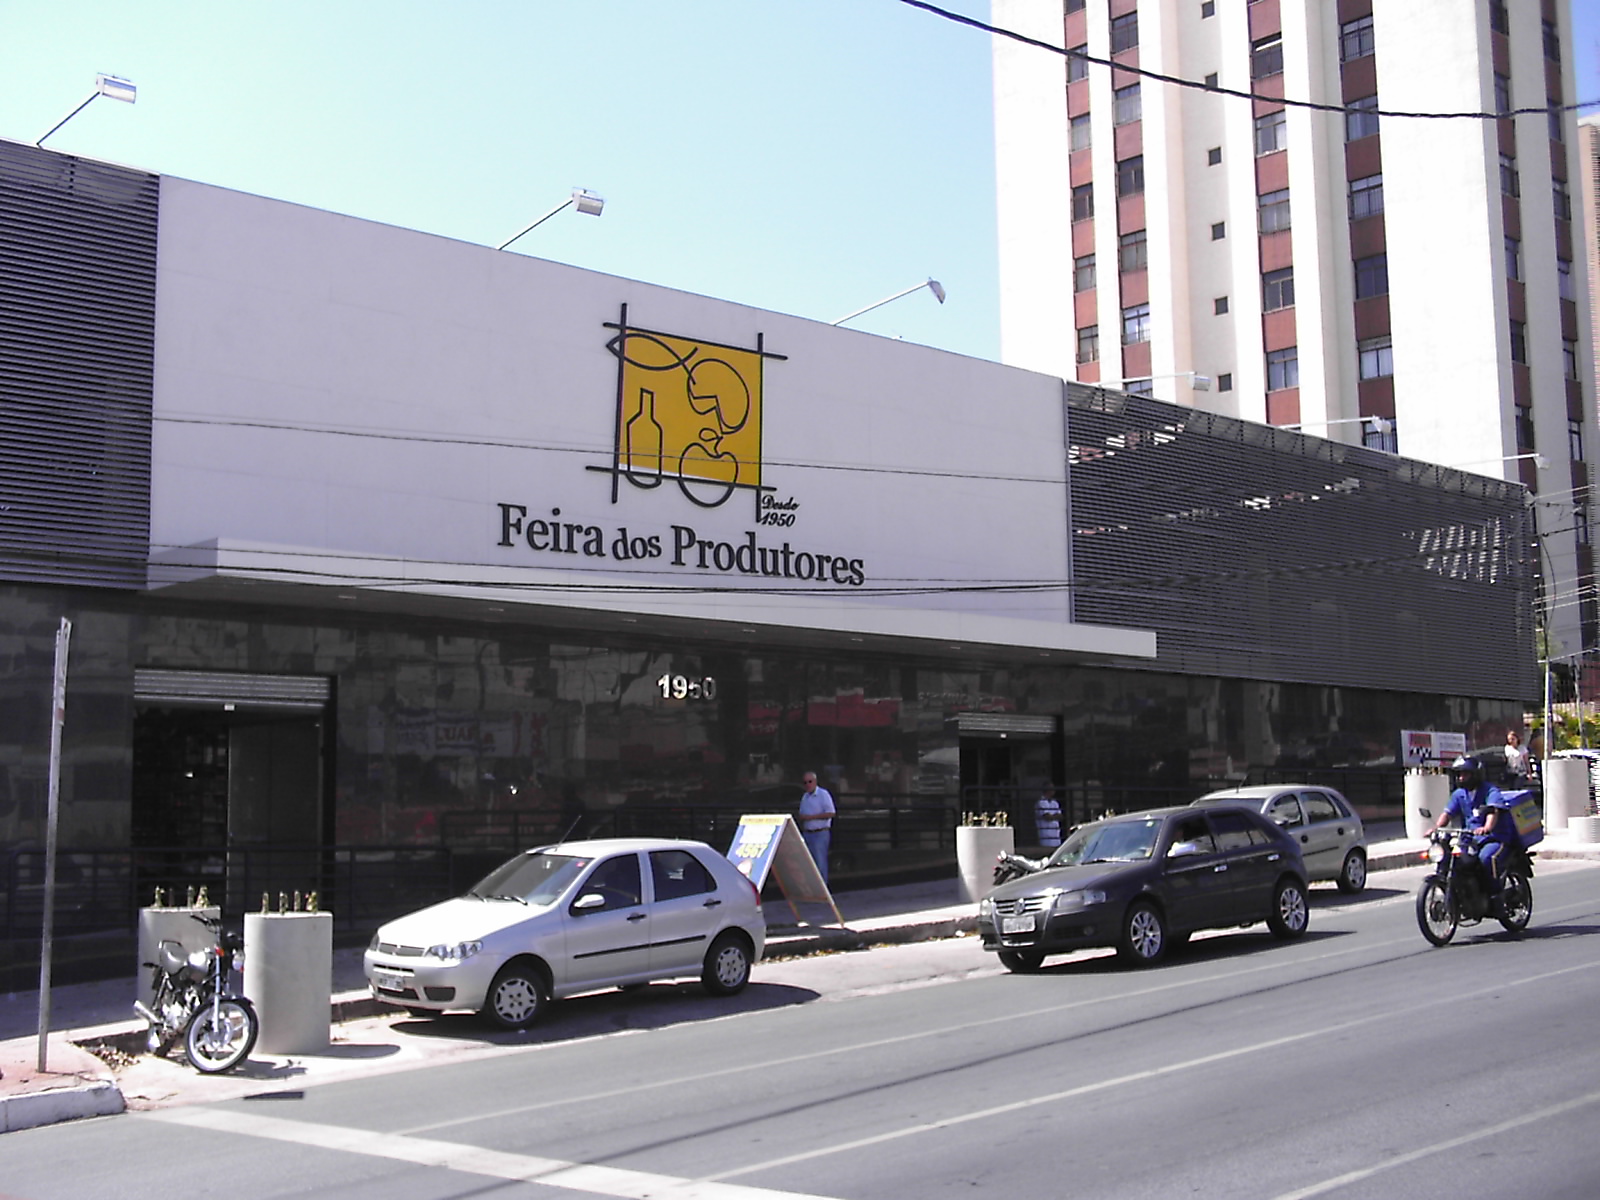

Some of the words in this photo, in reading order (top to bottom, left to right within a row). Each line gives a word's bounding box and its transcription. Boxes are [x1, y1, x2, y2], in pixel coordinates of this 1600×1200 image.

[761, 512, 796, 527] 1950
[497, 503, 606, 557] Feira
[611, 527, 662, 560] dos
[670, 525, 865, 586] Produtores
[657, 674, 717, 700] 1950
